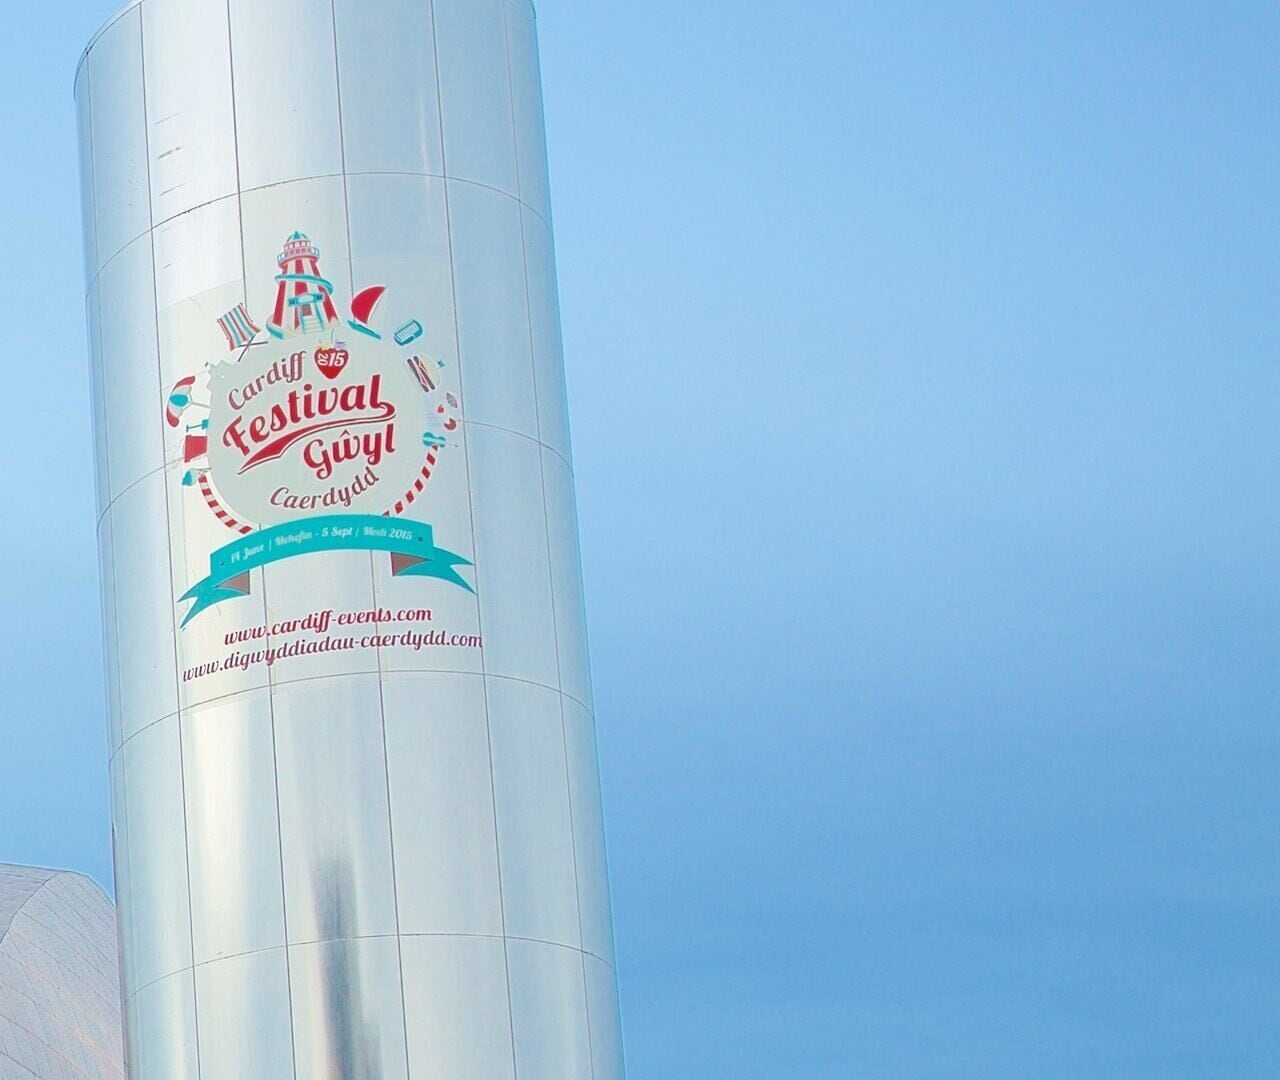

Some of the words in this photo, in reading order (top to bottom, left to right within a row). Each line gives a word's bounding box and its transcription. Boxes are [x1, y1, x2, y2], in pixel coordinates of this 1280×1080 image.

[228, 350, 307, 411] Cardiff
[222, 374, 395, 456] Festival
[303, 423, 396, 480] Gŵyl
[270, 466, 380, 510] Caerdydd
[242, 543, 265, 560] June
[321, 526, 329, 538] 5
[331, 525, 354, 539] Sept
[389, 528, 413, 541] 2015
[223, 607, 433, 646] www.cardiff-events.com
[182, 630, 484, 682] www.digwyddiadau-caerdydd.com
